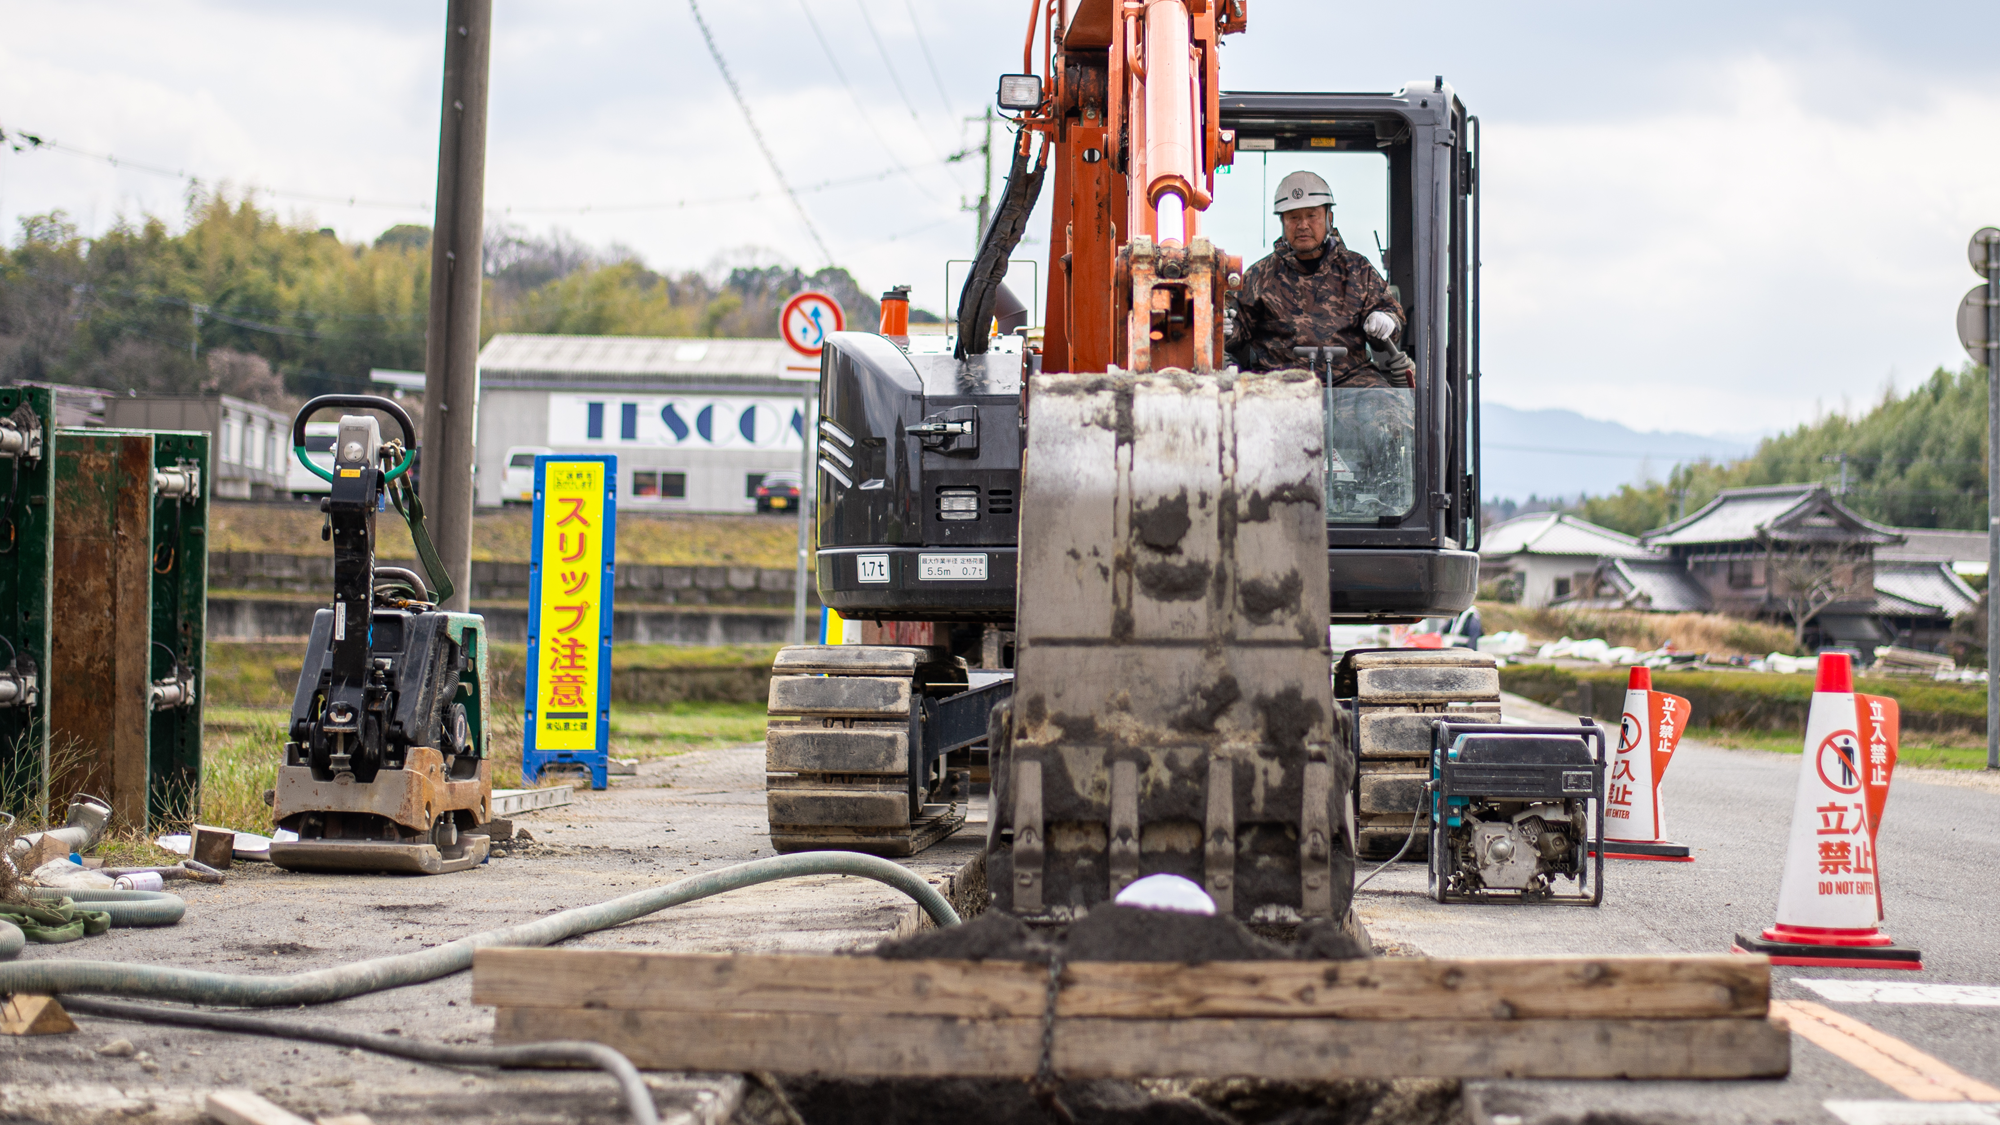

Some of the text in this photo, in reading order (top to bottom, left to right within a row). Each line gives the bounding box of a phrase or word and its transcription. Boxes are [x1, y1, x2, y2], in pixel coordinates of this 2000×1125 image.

[927, 566, 951, 576] 5.5m
[549, 498, 590, 708] スリップ注意
[1657, 697, 1676, 753] 立入禁止
[1870, 701, 1887, 786] 立入禁止
[1816, 801, 1869, 836] 立入
[1818, 840, 1873, 875] 禁止
[1818, 881, 1833, 895] DO
[1835, 881, 1854, 895] NOT
